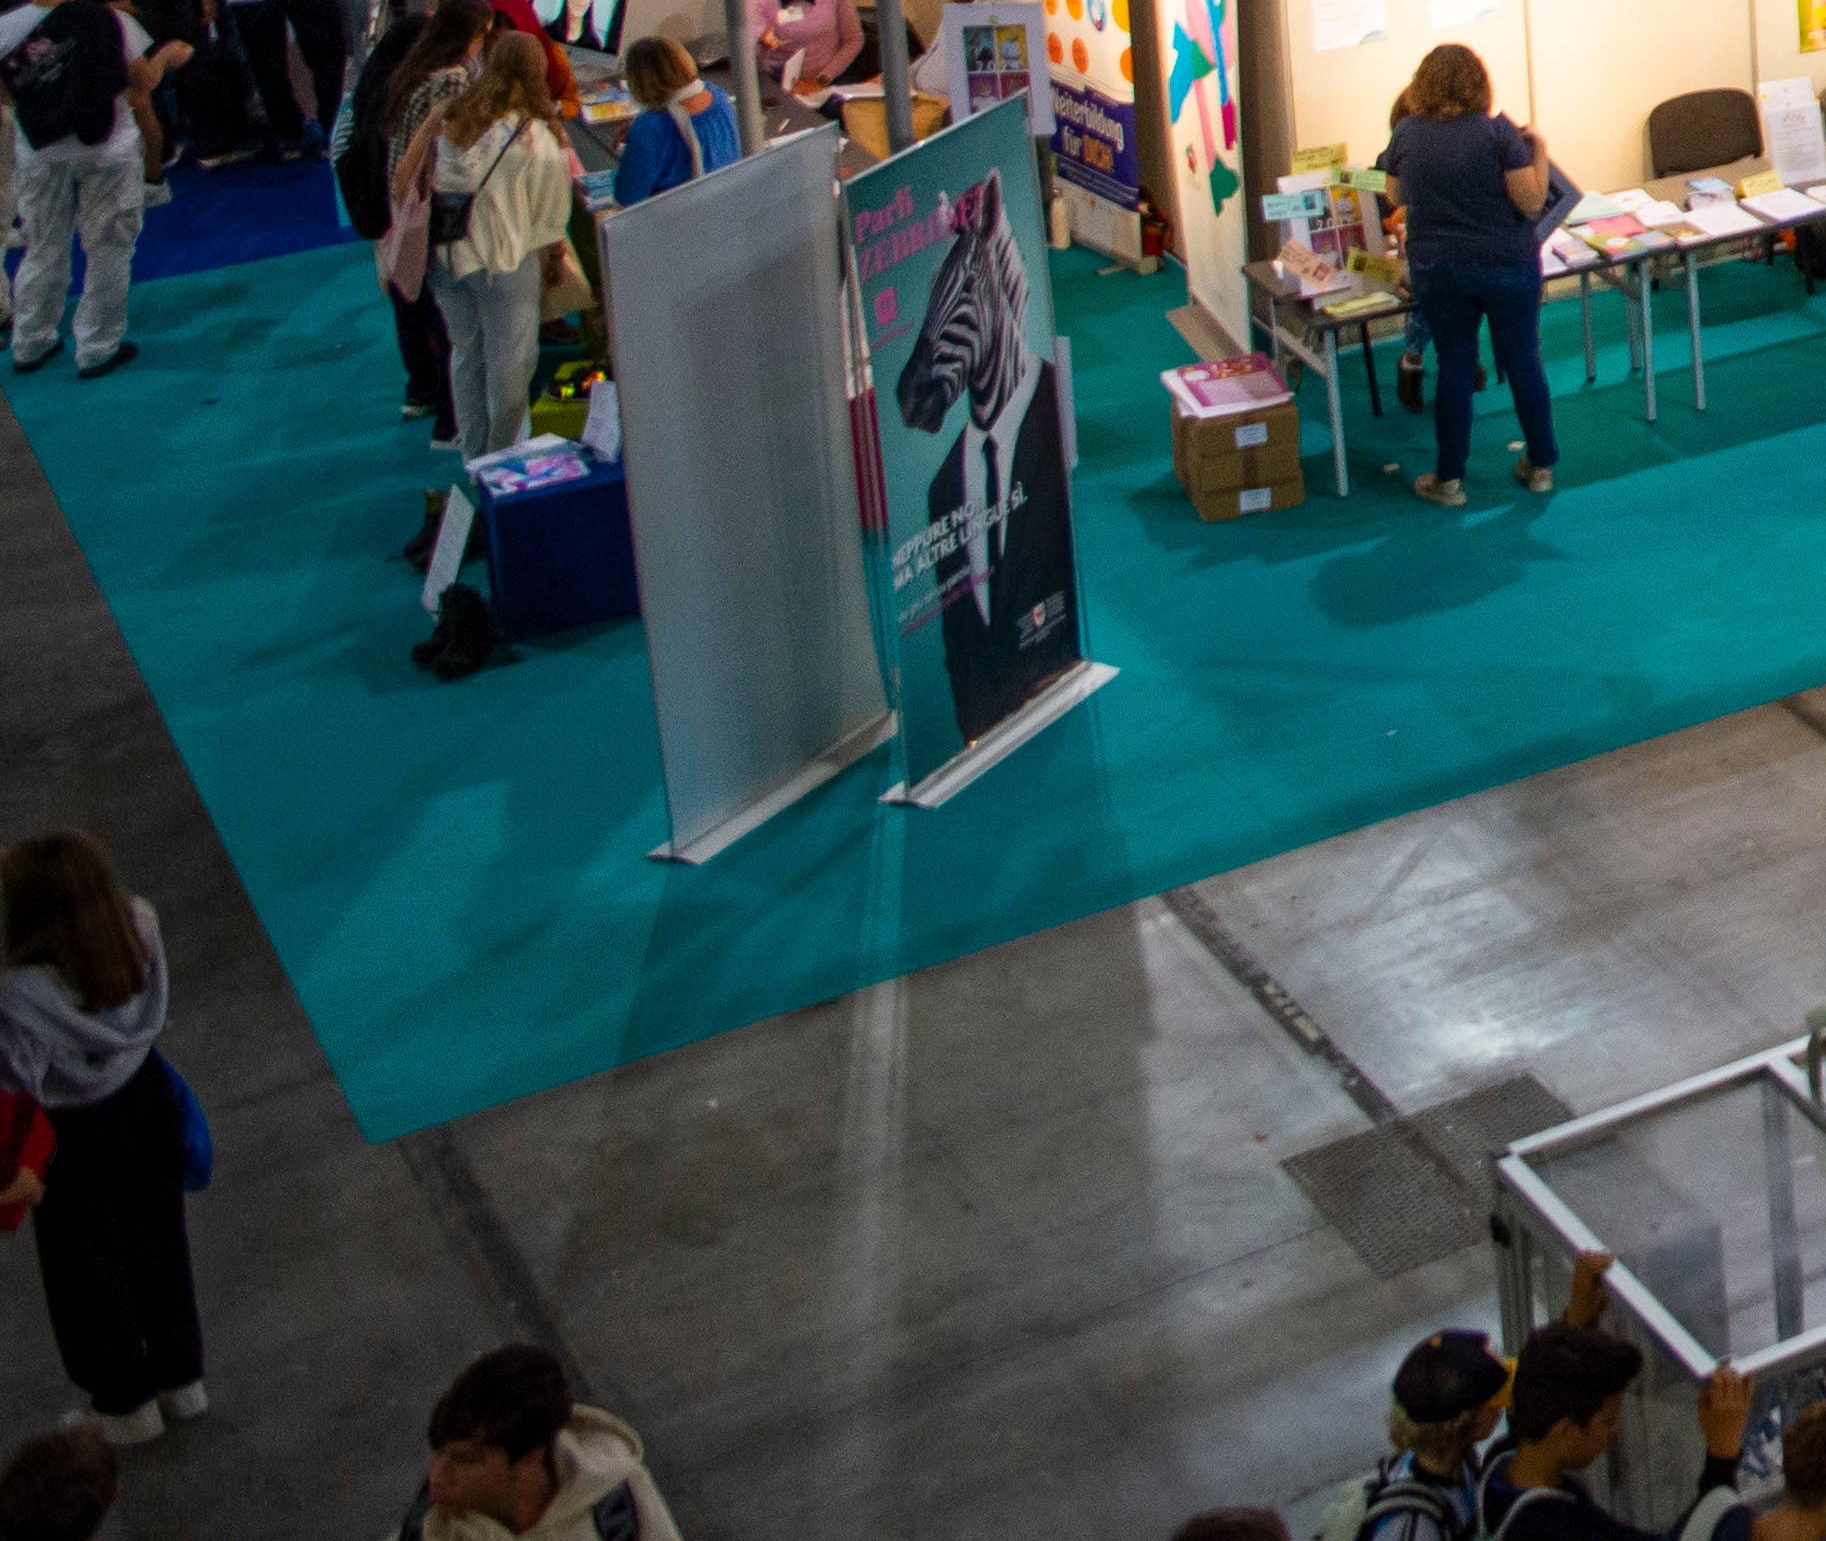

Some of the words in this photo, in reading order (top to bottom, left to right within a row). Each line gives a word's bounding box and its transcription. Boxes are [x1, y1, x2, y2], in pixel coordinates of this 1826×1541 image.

[1062, 125, 1082, 157] für
[855, 184, 914, 244] Parli
[892, 509, 950, 570] NEPPURE
